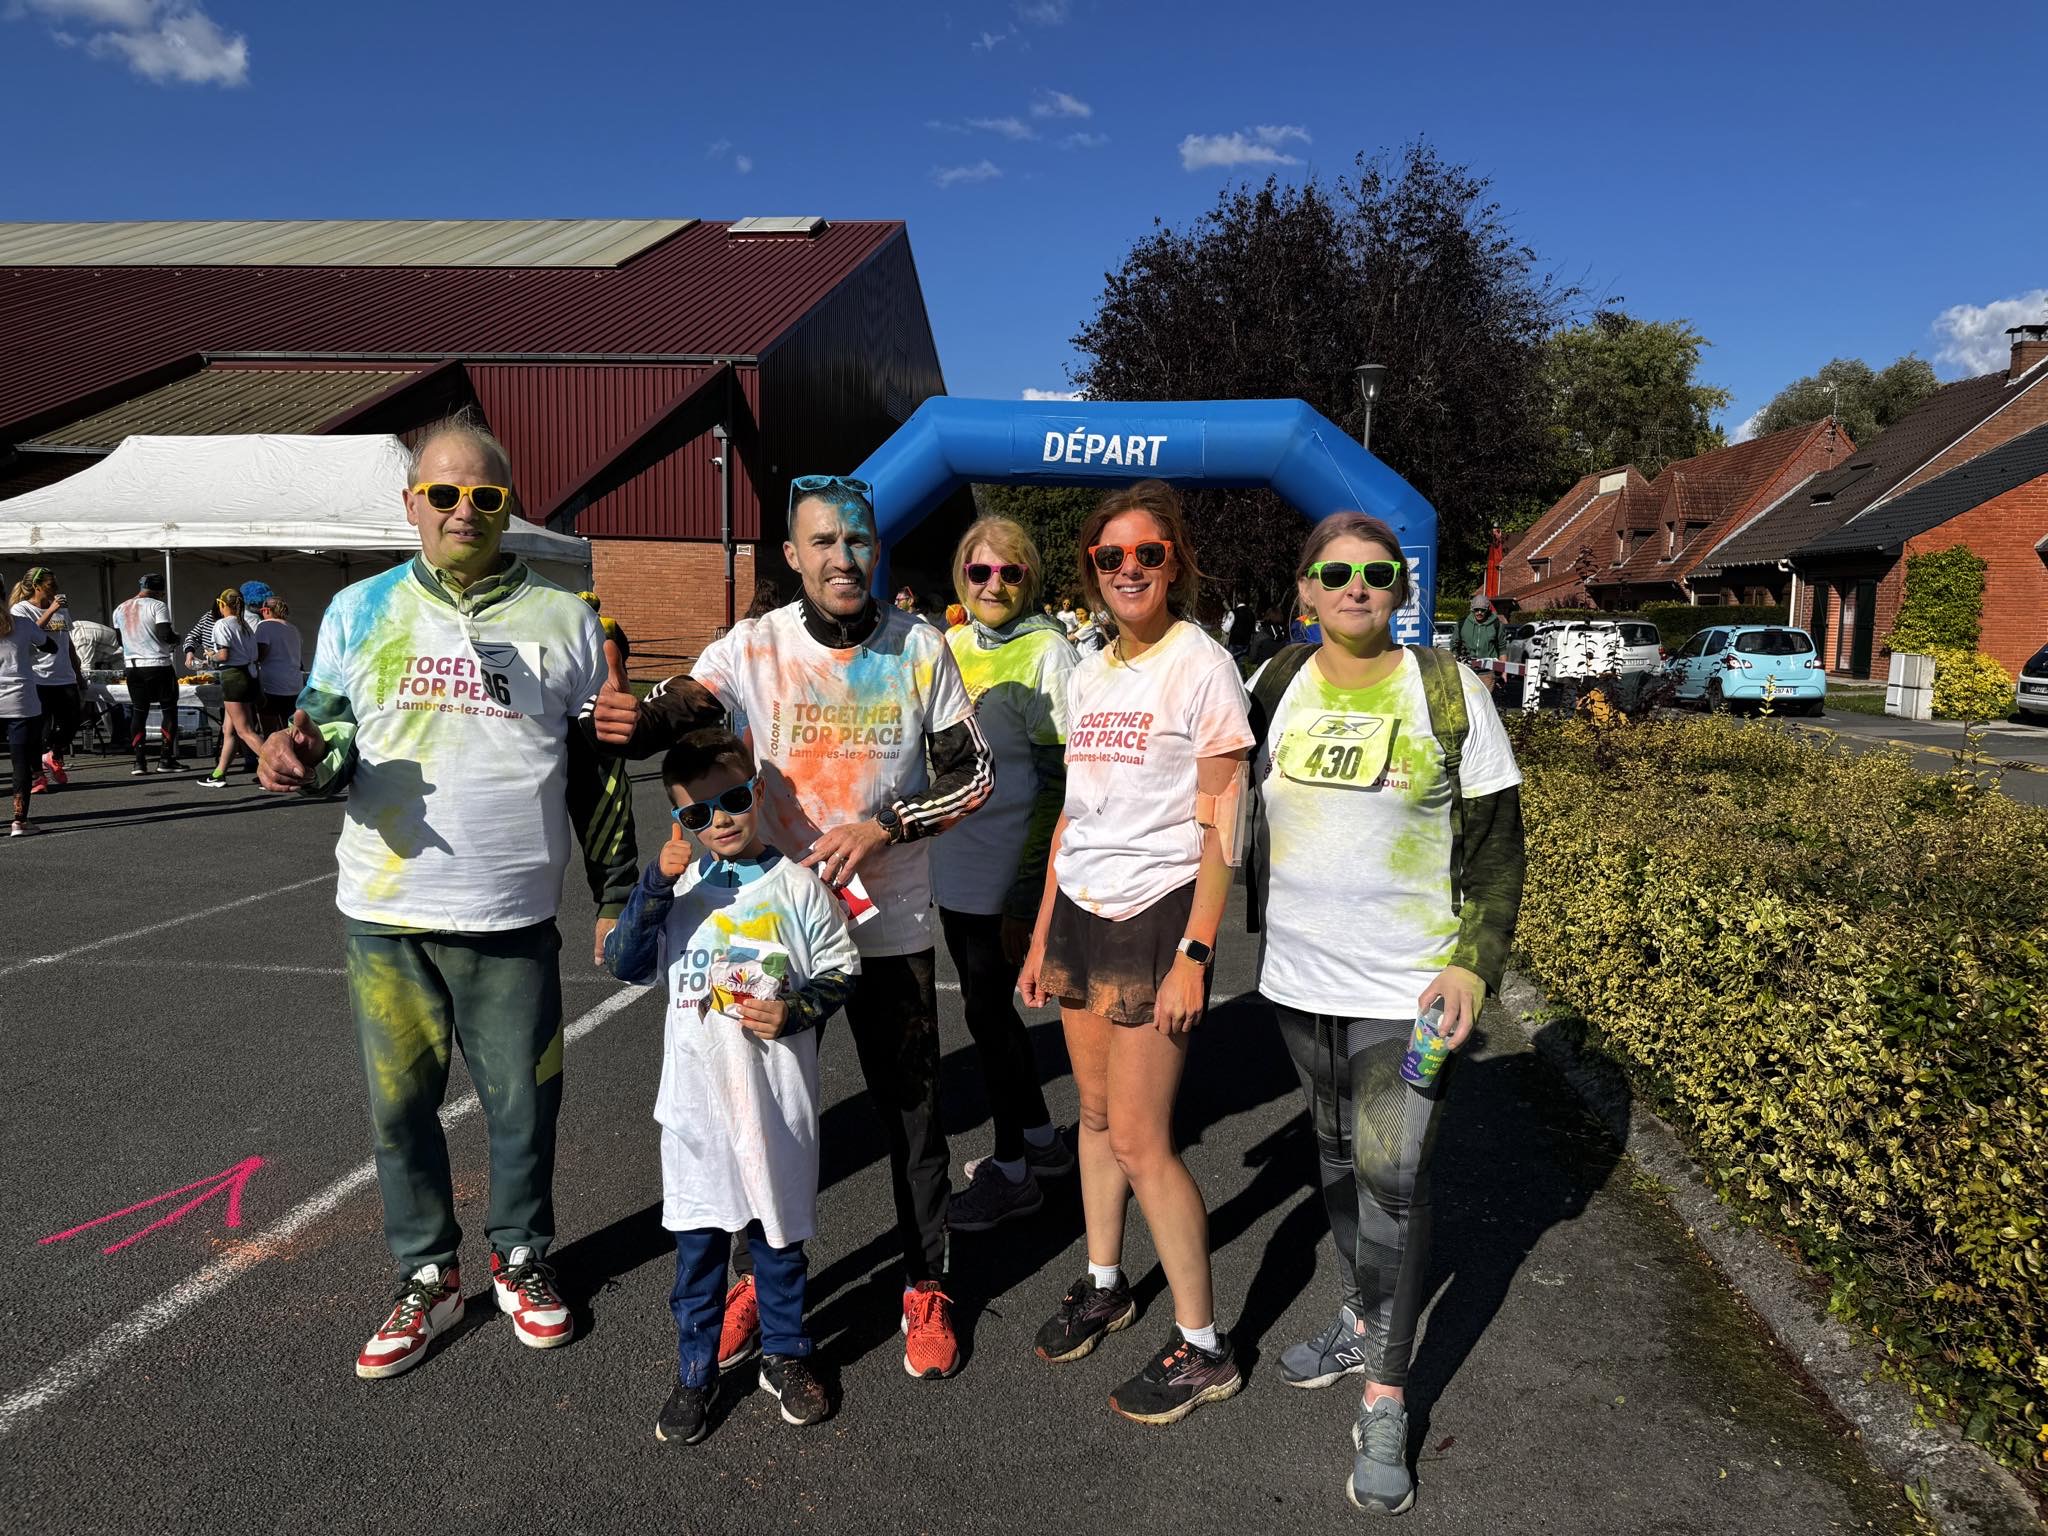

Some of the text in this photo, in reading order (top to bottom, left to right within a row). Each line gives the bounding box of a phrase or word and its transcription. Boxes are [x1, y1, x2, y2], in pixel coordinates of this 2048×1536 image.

[1042, 426, 1168, 467] DÉPART
[404, 656, 477, 679] TOGET
[399, 677, 447, 698] FOR
[794, 703, 903, 725] TOGETHER
[770, 700, 781, 757] COLOR RUN
[791, 725, 903, 746] FOR PEACE
[1096, 731, 1149, 751] PEACE
[789, 747, 901, 760] Lambres-lez-Douai
[1304, 744, 1364, 781] 430
[678, 972, 711, 993] FO
